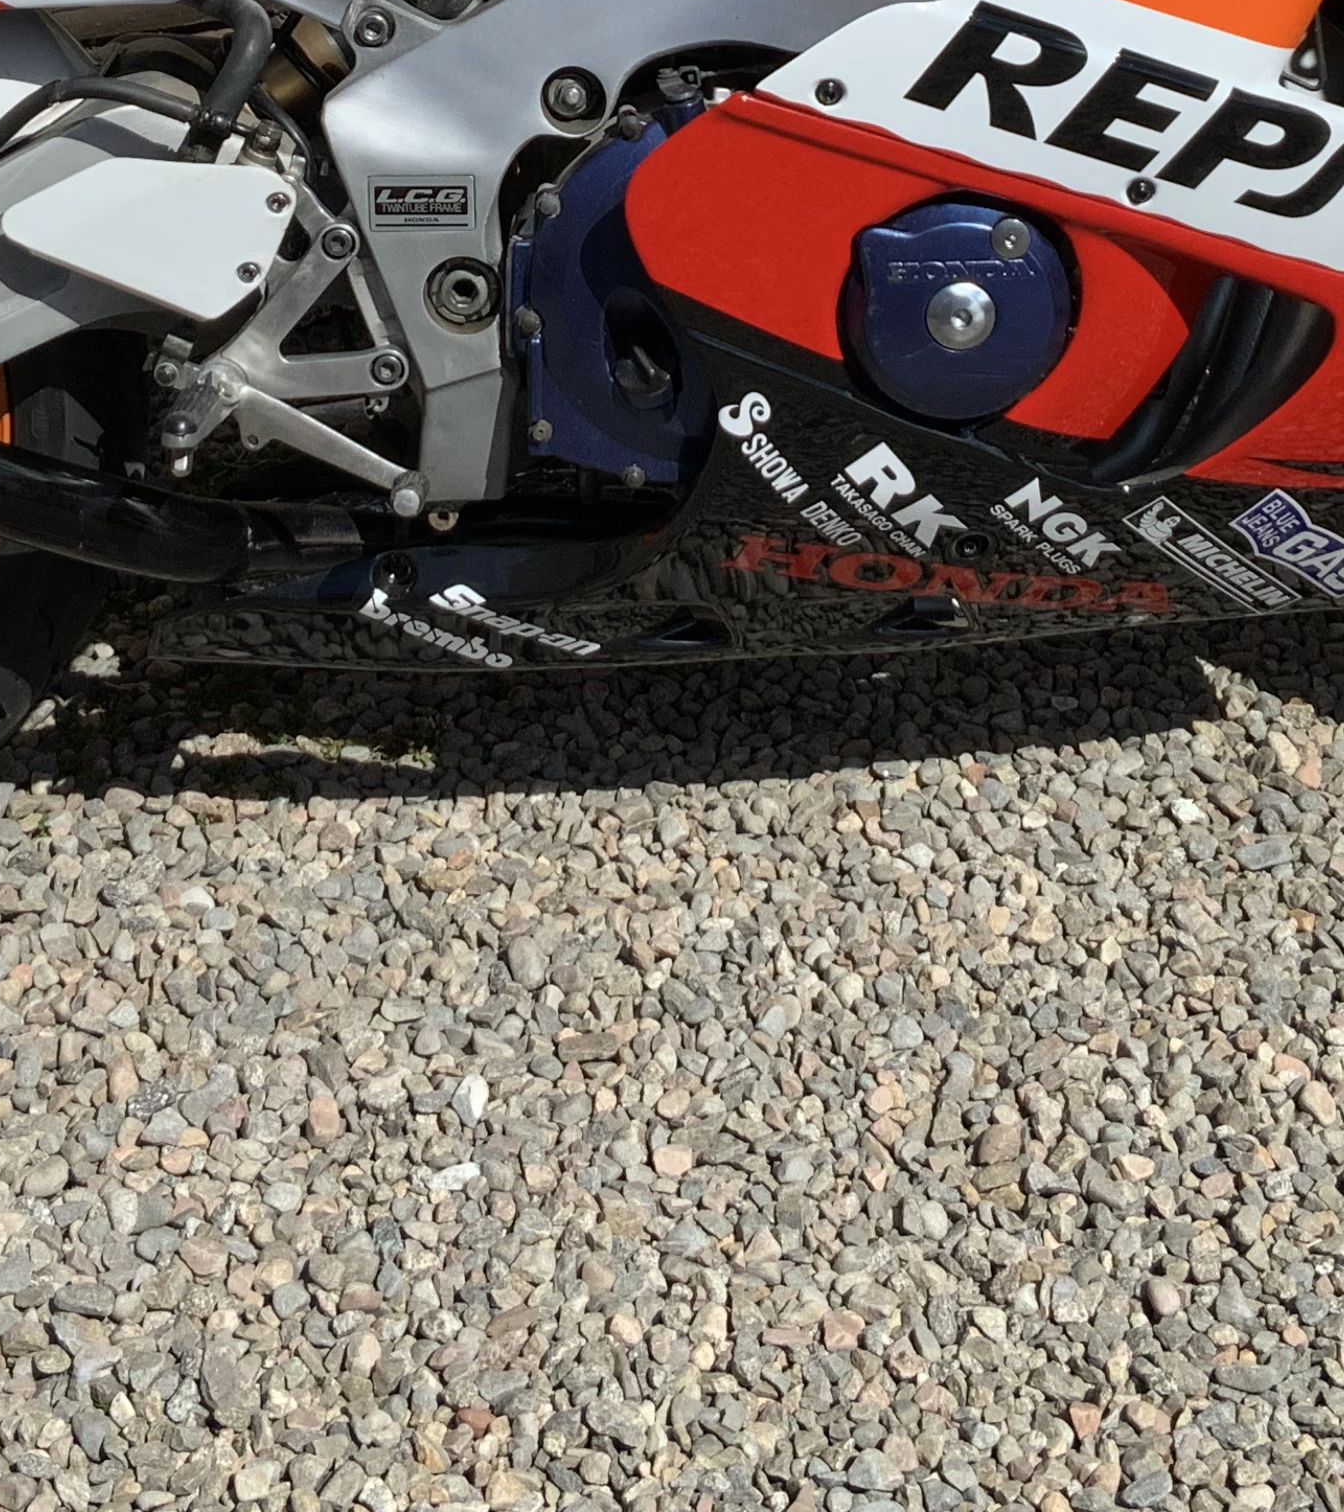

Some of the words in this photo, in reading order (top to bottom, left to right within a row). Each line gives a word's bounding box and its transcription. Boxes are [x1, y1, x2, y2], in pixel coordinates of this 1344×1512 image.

[376, 188, 466, 204] L.C.G.
[381, 203, 428, 213] TWINTUBE
[429, 203, 462, 213] FRAME
[888, 258, 1037, 282] HONDA
[741, 433, 810, 504] SHOWA
[800, 500, 862, 547] DENKO
[830, 473, 893, 532] TAKASAGO
[889, 530, 926, 558] CHAIN
[844, 441, 969, 549] RK
[1004, 476, 1122, 568] NGK
[1262, 499, 1301, 534] BLUE
[989, 504, 1039, 543] SPARK
[1035, 541, 1081, 575] PLUGS
[1241, 513, 1281, 548] JEANS
[718, 534, 1173, 614] HONDA
[1177, 533, 1291, 607] MICHELIN
[358, 588, 514, 668] brembo
[429, 583, 601, 656] Snap-on
